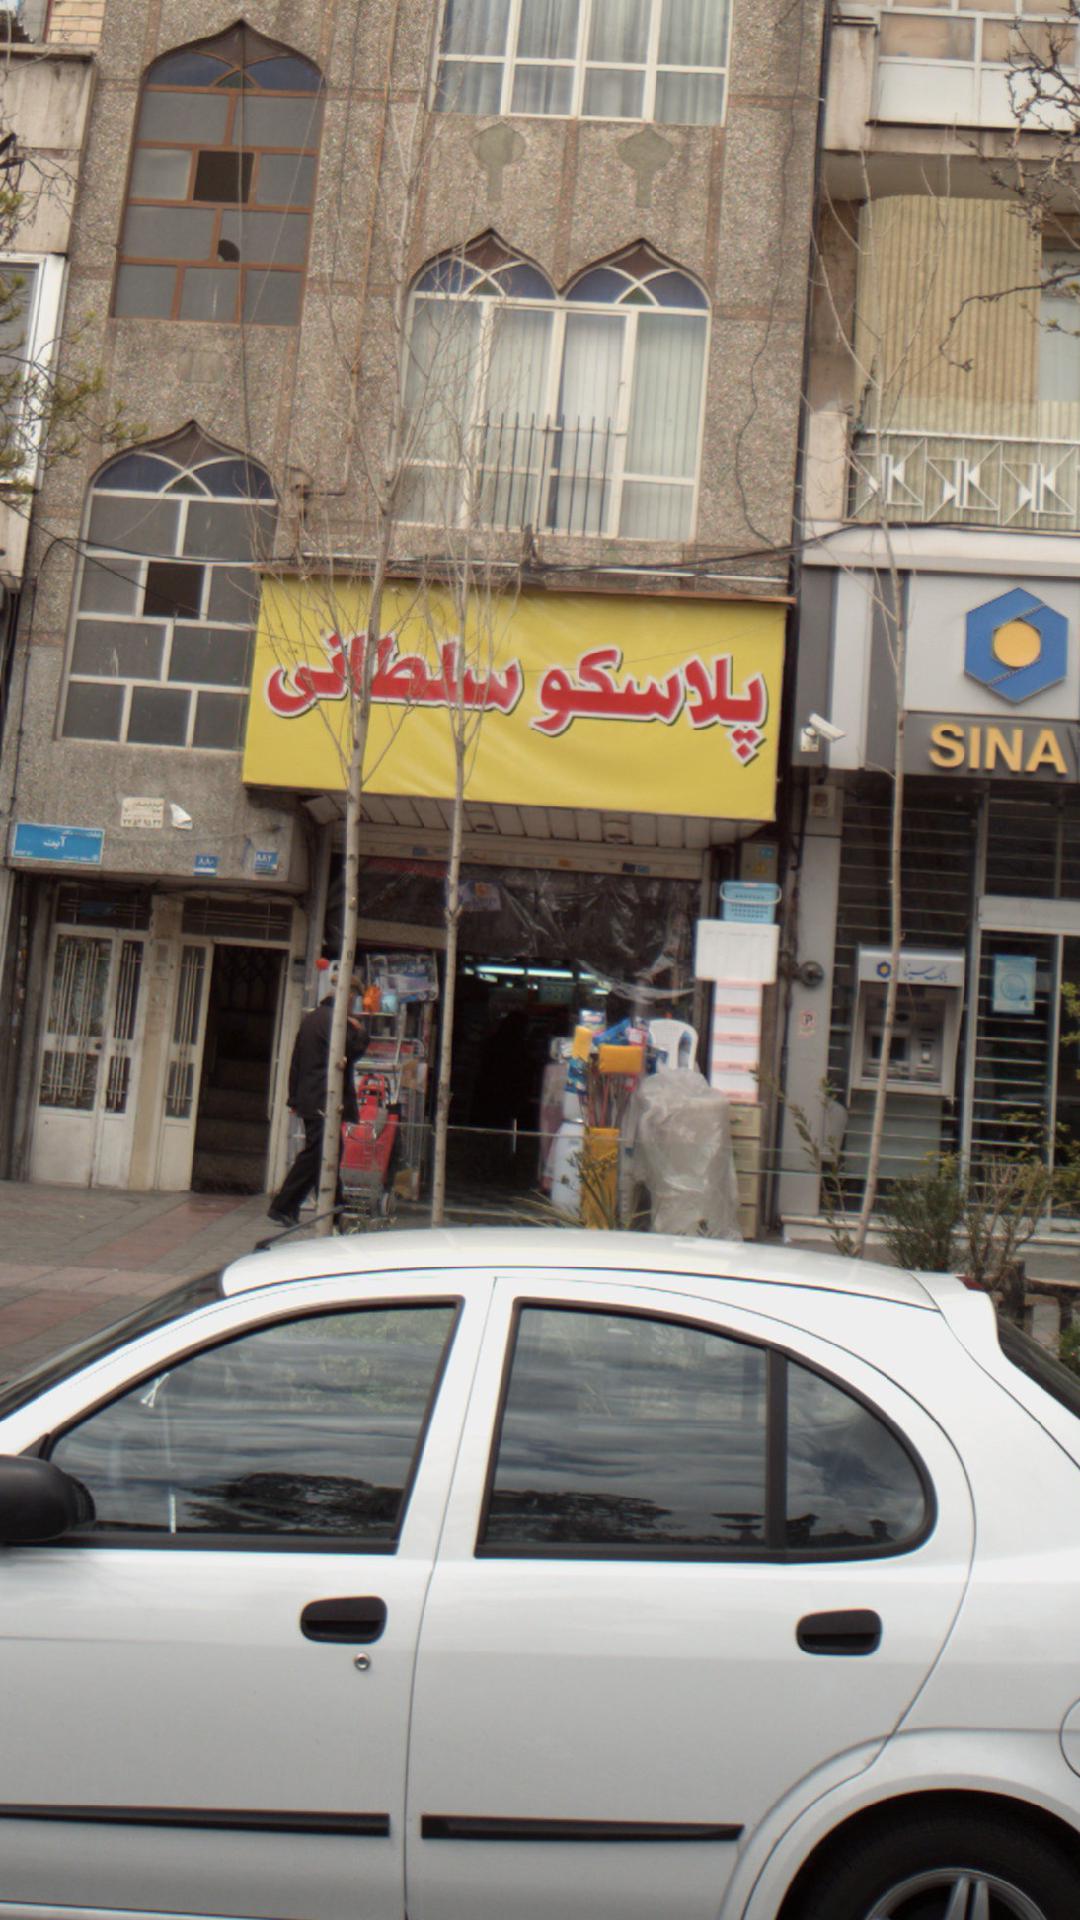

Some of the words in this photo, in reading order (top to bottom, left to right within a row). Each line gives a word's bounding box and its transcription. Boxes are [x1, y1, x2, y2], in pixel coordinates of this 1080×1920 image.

[264, 630, 523, 716] سلطانی
[529, 643, 768, 765] پلاسکو
[928, 722, 1069, 775] SINA
